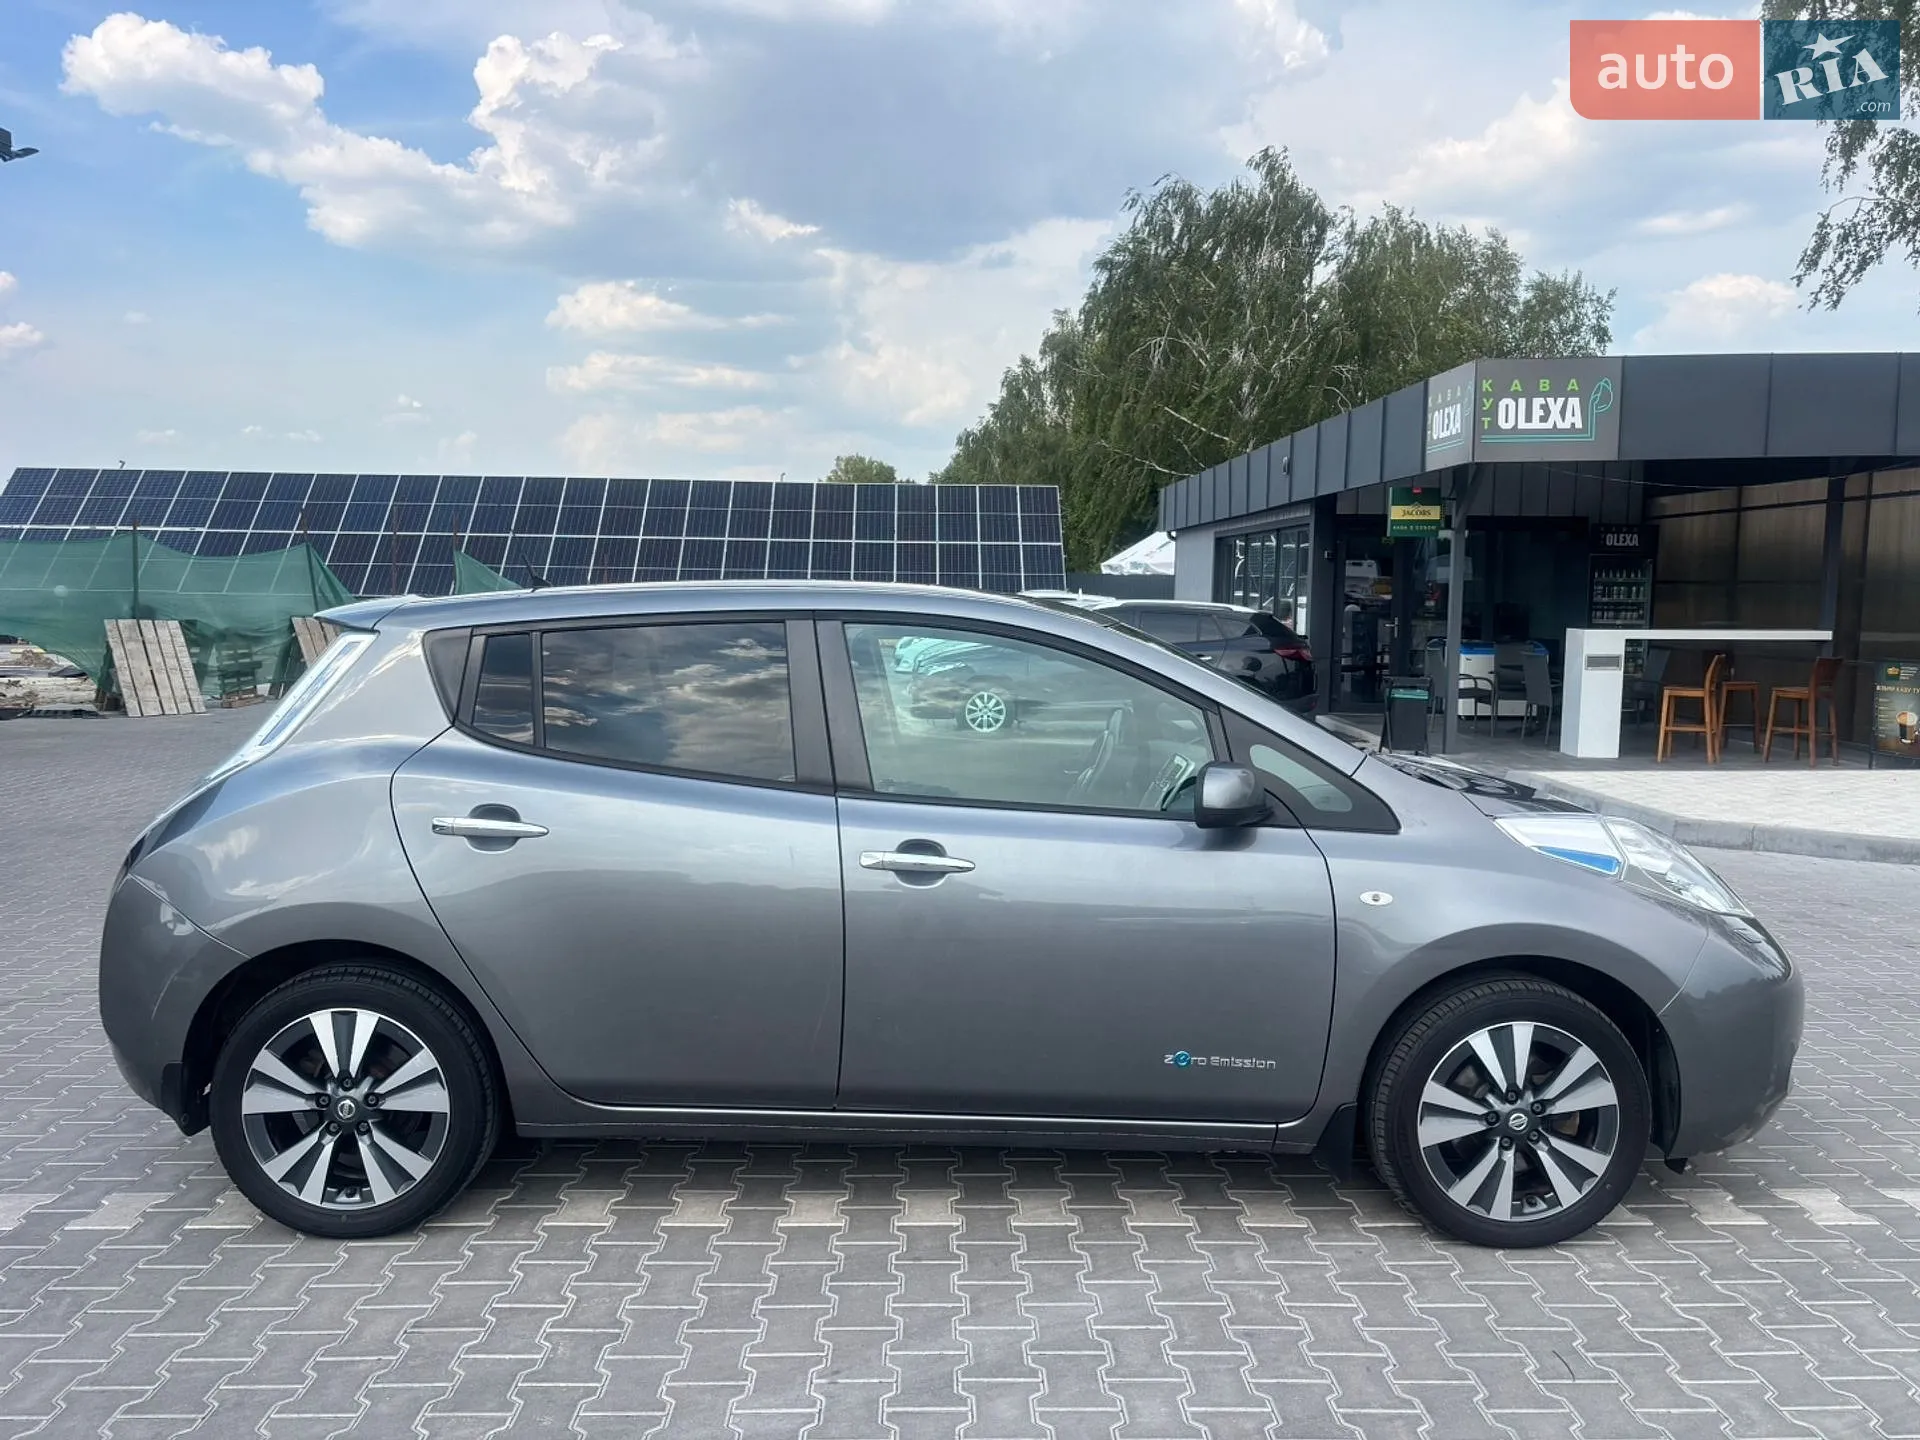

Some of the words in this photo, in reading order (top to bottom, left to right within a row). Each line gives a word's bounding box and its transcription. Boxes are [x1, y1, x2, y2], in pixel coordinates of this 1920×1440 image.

[1432, 403, 1461, 440] OLEXA
[1497, 397, 1583, 430] OLEXA
[1605, 533, 1640, 547] OLEXA
[1210, 1056, 1277, 1069] Emission
